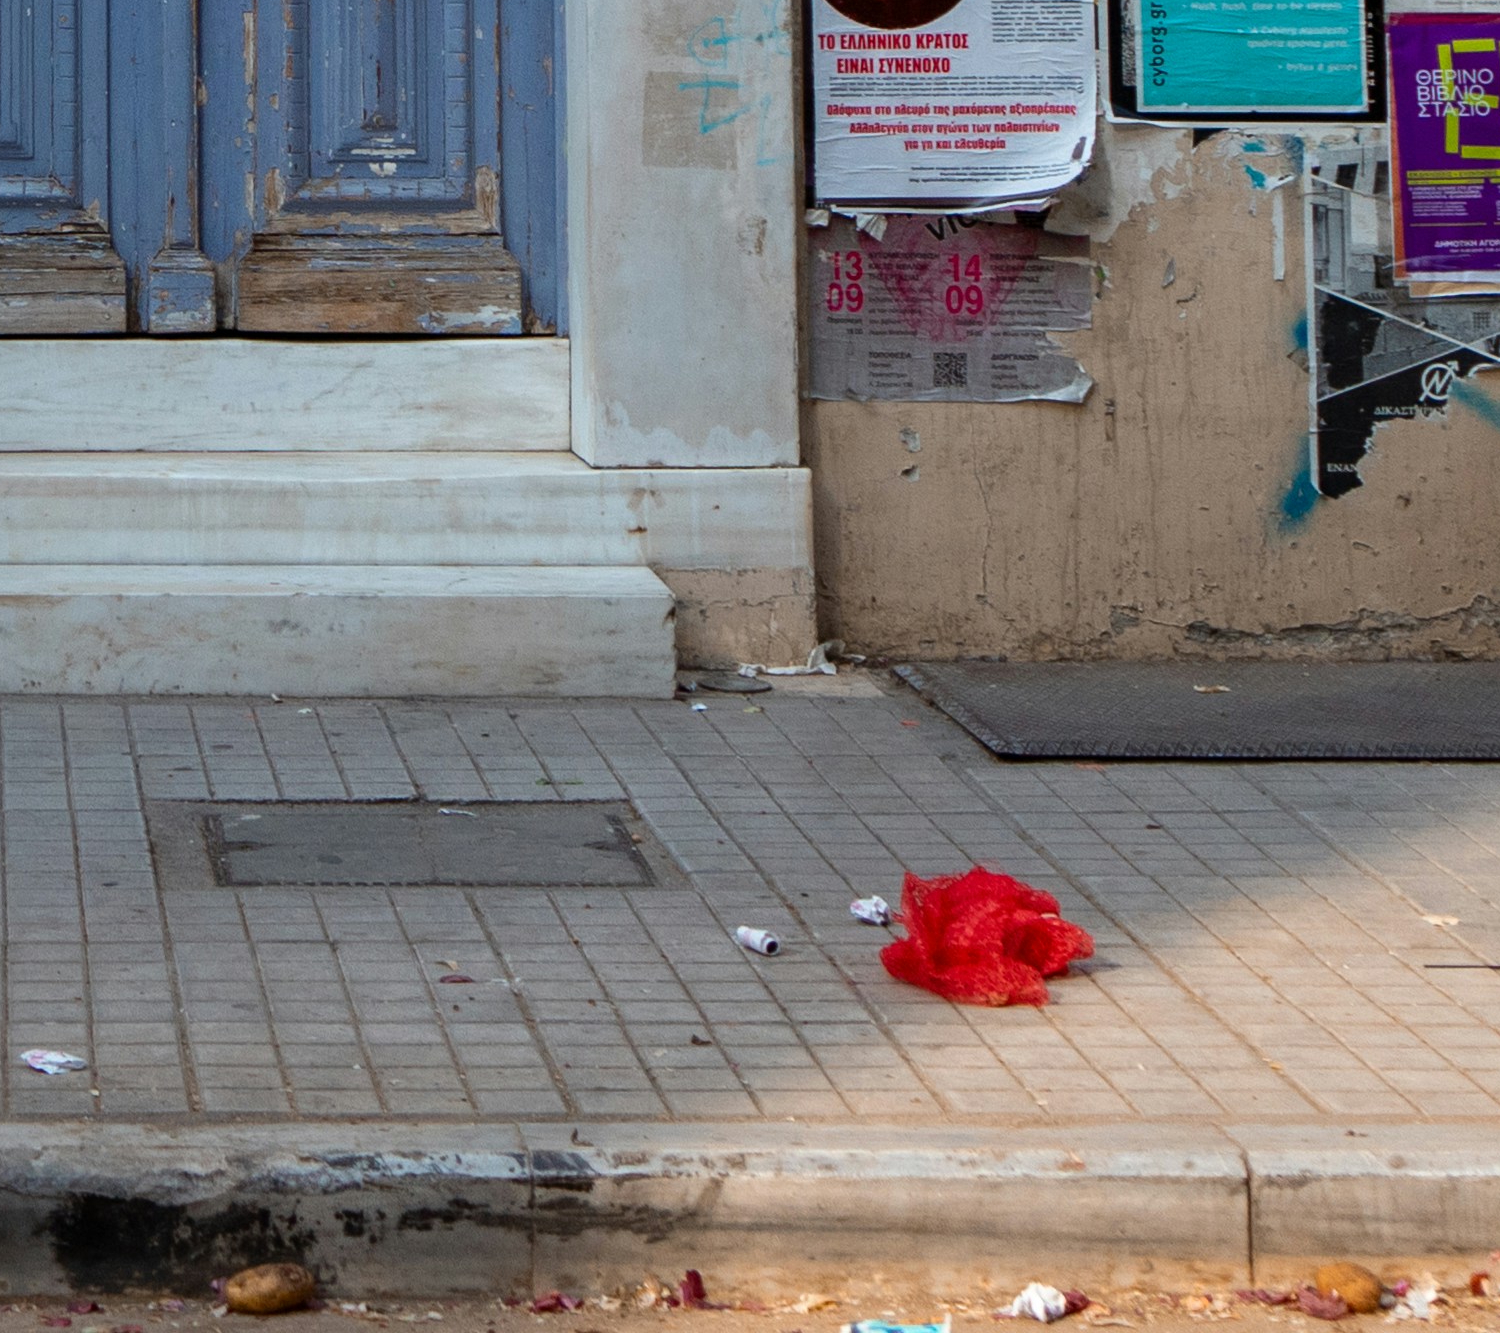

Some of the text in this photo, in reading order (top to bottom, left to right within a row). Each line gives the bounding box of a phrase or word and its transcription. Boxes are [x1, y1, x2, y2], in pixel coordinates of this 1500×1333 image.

[818, 33, 969, 50] ΤΟ ΕΛΛΗΝΙΚΟ ΚΡΑΤΟΣ
[1151, 0, 1167, 87] cyborg.gr
[837, 57, 951, 75] ΕΙΝΑΙ ΣΥΝΕΝΟΧΟ
[1416, 69, 1494, 86] ΘΕΡΙΝΟ
[1417, 85, 1485, 102] ΒΙΒΛΙΟ
[875, 106, 892, 115] στο
[894, 104, 931, 117] πλευρό
[933, 105, 950, 116] της
[952, 103, 1006, 116] μαχόμενης
[1009, 102, 1077, 116] αξιοπρέπειας
[1418, 101, 1491, 118] ΣΤΑΣΙΟ
[849, 120, 1060, 136] Αλληλεγγύη στον αγώνα των παλαιστινίων
[903, 137, 1006, 151] για γη και ελευθερία
[829, 250, 863, 282] 13
[947, 253, 983, 283] 14
[826, 283, 864, 313] 09
[945, 285, 984, 315] 09
